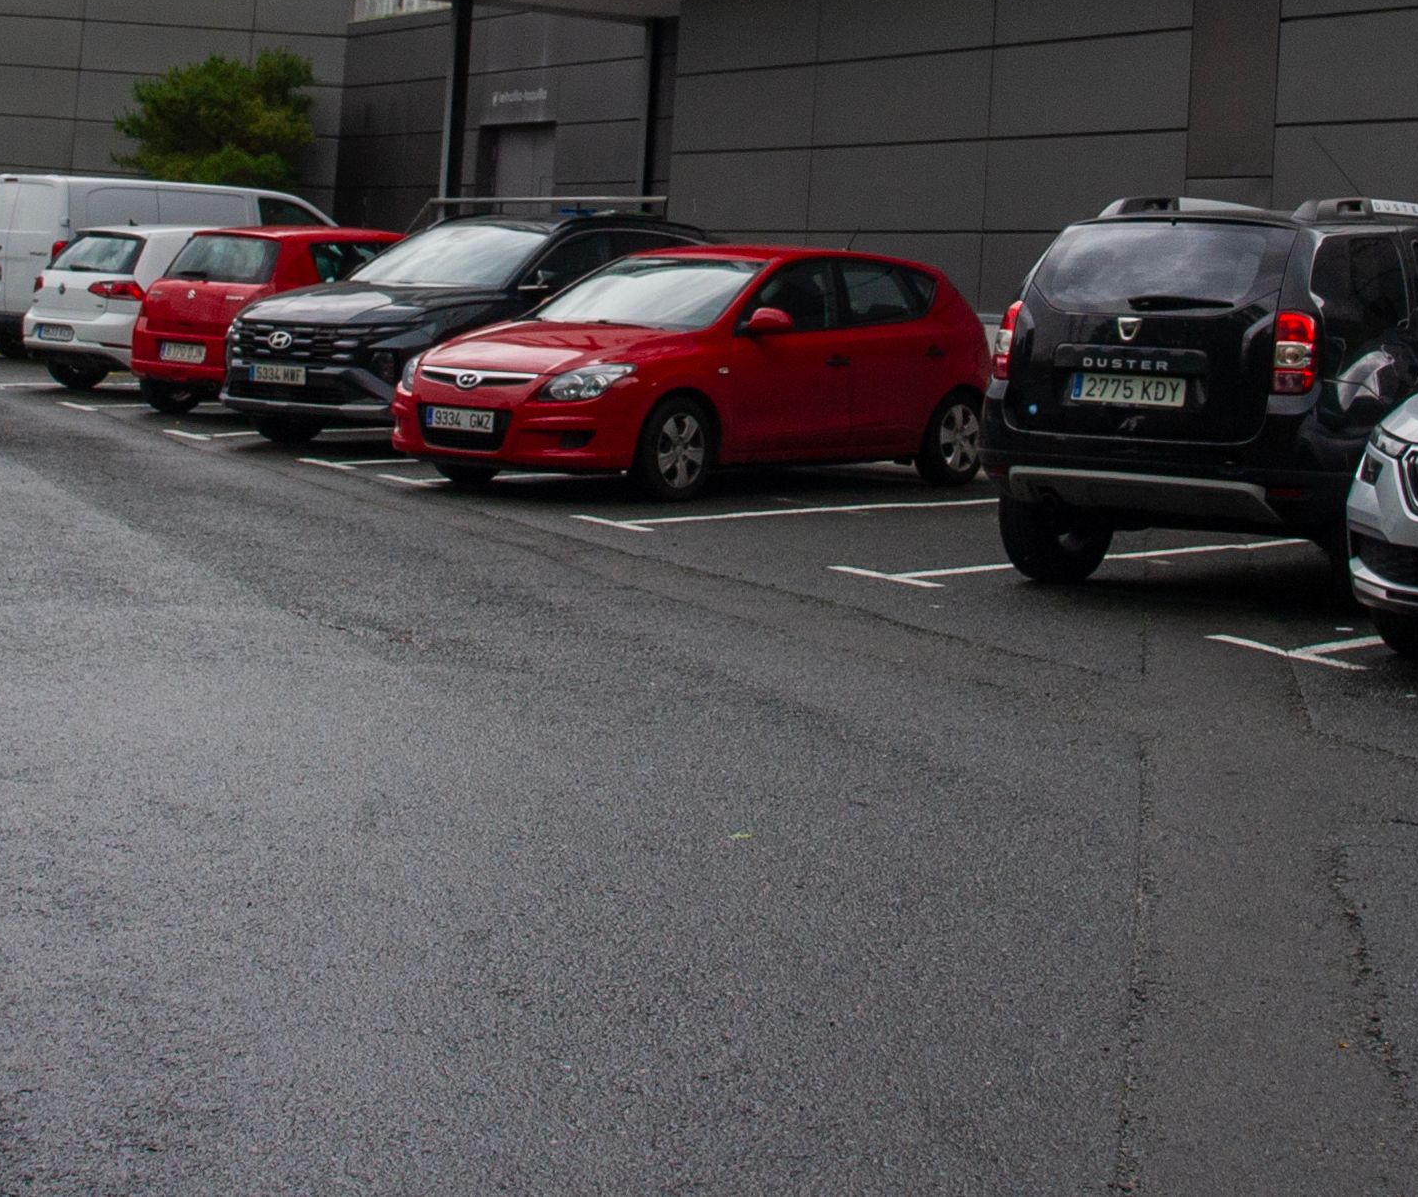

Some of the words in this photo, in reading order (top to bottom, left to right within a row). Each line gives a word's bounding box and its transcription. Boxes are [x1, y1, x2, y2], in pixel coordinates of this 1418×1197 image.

[1082, 357, 1169, 371] DUSTER
[256, 366, 280, 380] 5334
[1085, 377, 1134, 399] 2775
[1141, 380, 1181, 403] KDY
[434, 410, 461, 428] 9334
[469, 413, 491, 430] GMZ
